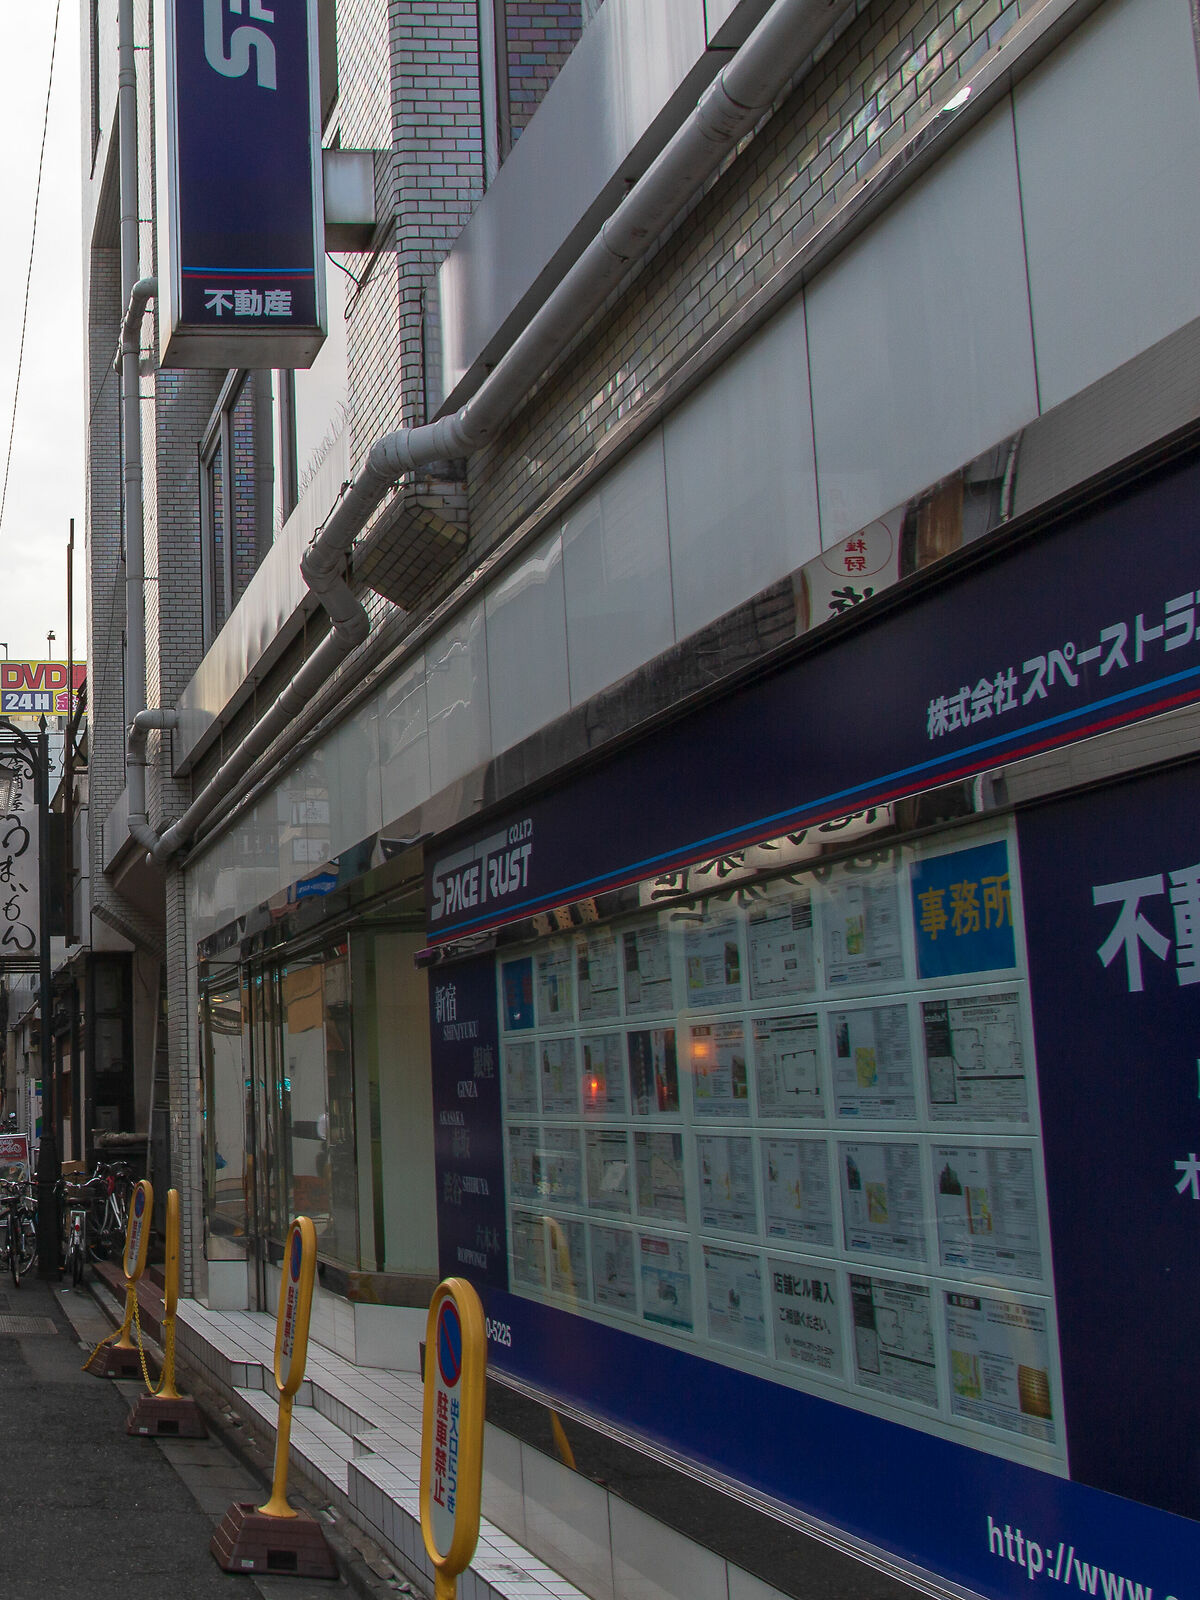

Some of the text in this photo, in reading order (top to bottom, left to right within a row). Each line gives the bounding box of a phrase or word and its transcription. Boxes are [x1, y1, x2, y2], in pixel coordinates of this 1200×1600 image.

[203, 288, 293, 317] 不動産
[917, 871, 1014, 941] 事務所
[434, 983, 457, 1024] 新宿
[433, 1389, 449, 1508] 駐車禁止
